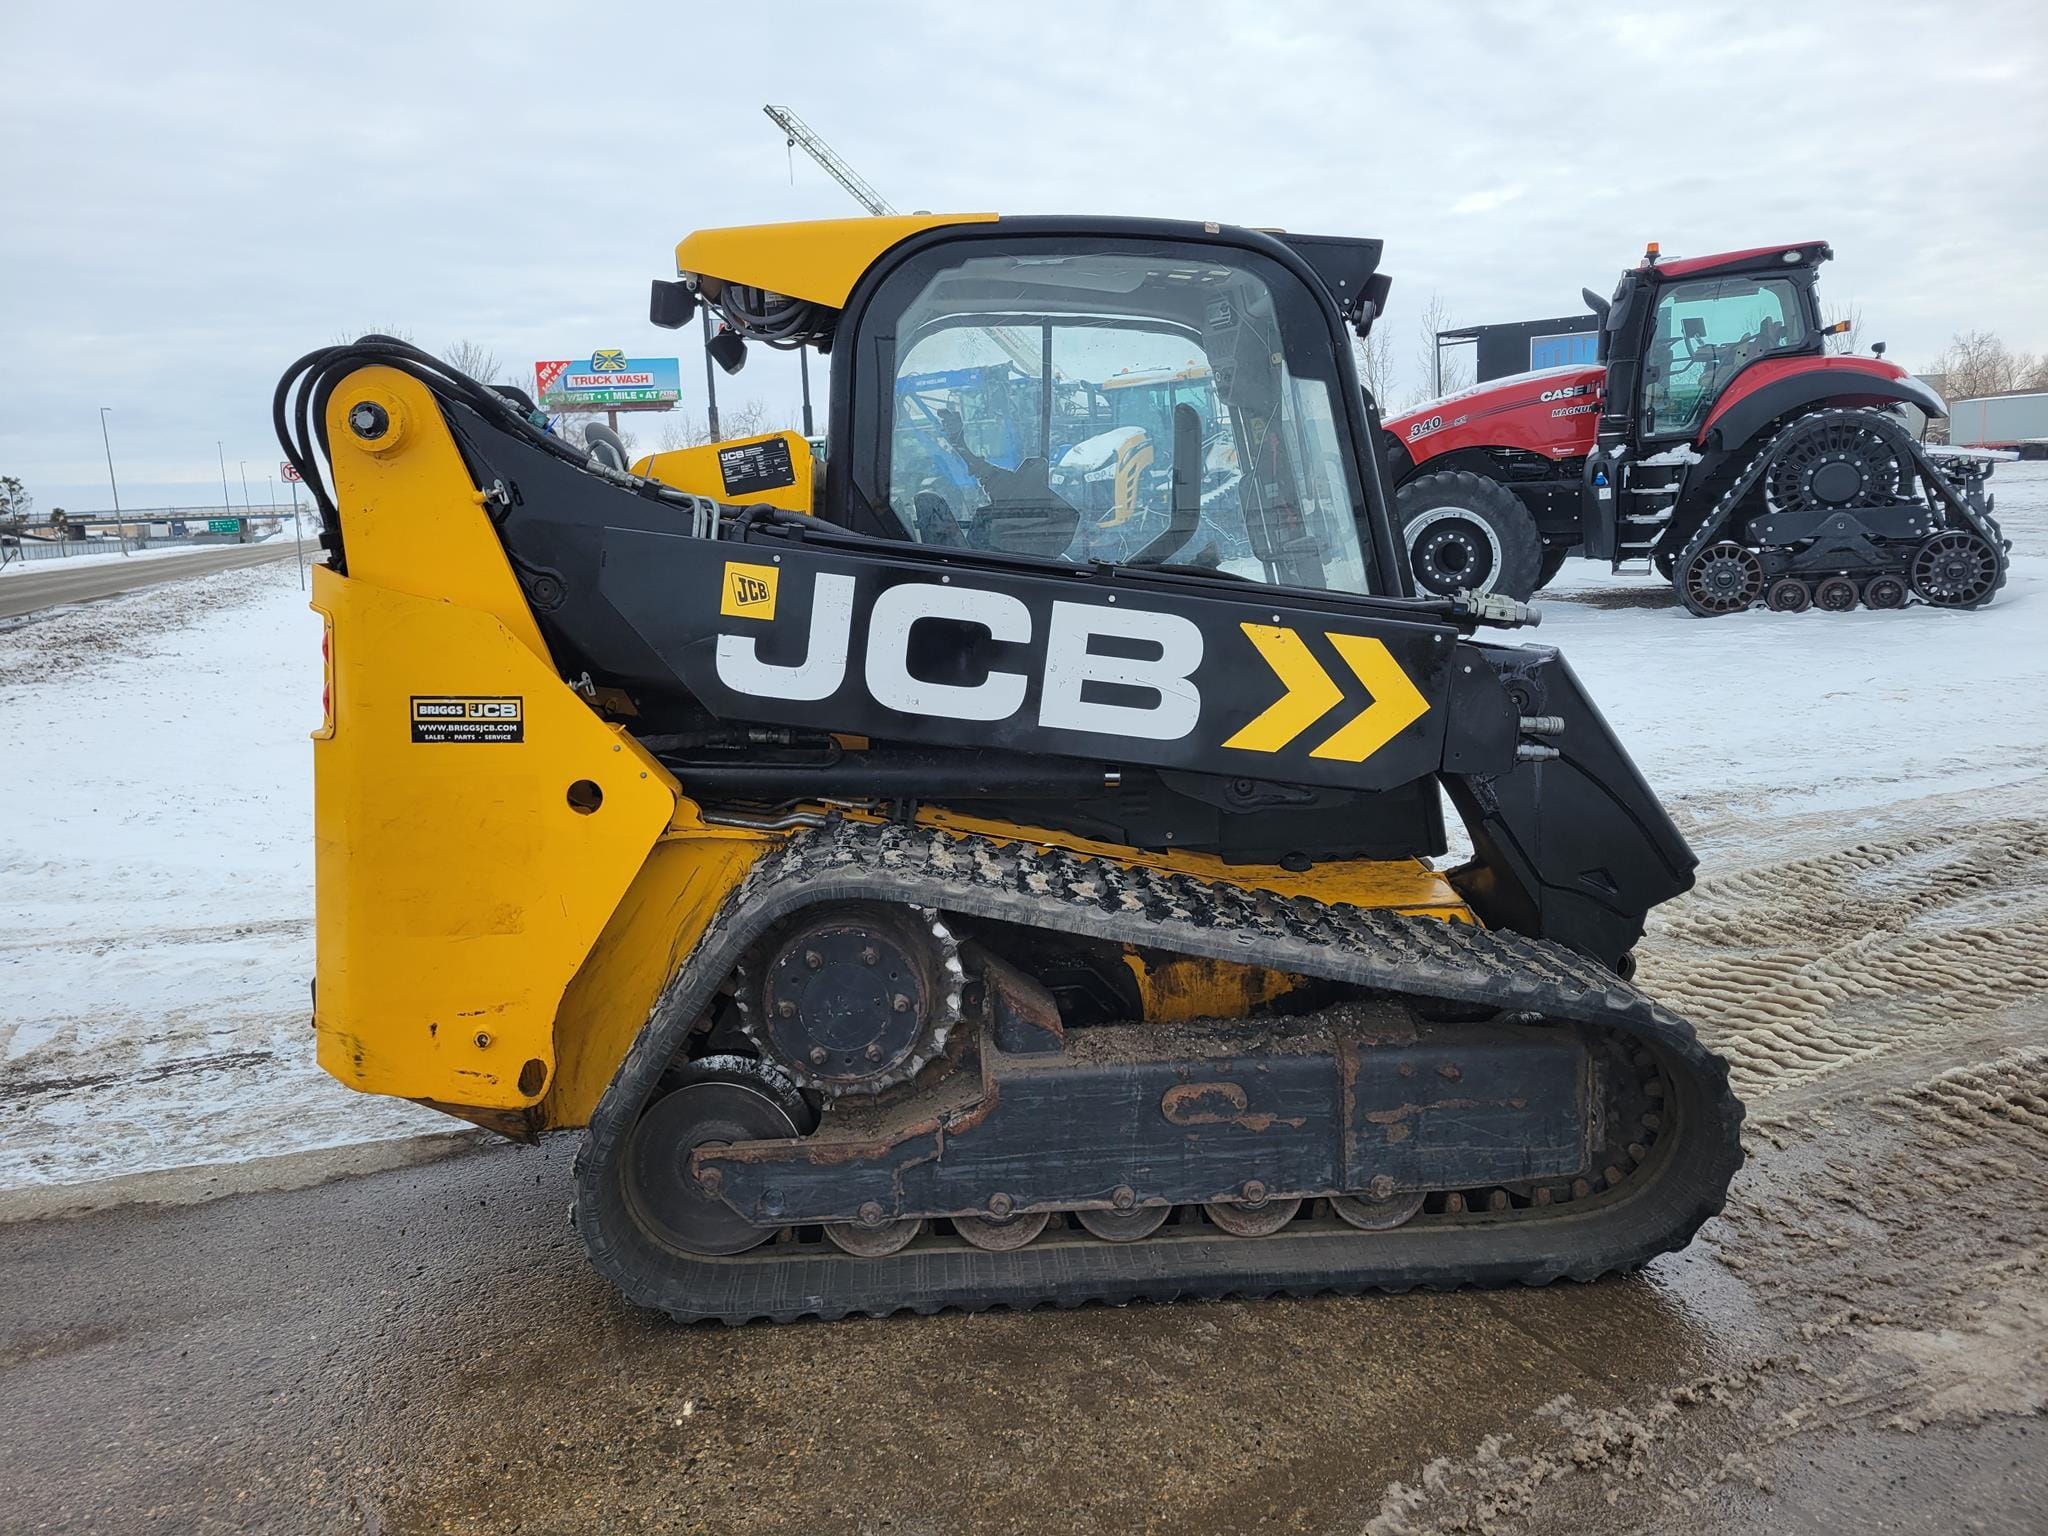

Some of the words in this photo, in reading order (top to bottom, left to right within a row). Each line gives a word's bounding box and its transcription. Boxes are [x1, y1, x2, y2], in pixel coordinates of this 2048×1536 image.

[573, 375, 612, 385] TRUCK
[615, 374, 649, 384] WASH
[604, 392, 609, 400] 1
[613, 391, 637, 400] MILE
[644, 391, 658, 399] AT
[1540, 384, 1584, 402] CASE
[1551, 403, 1593, 418] MAGNU
[1411, 416, 1442, 436] 340
[720, 450, 745, 461] JCB
[737, 576, 768, 603] JCB
[716, 572, 1204, 741] JCB
[419, 705, 464, 715] BRIGGS
[469, 703, 517, 717] JCB
[418, 724, 517, 733] WWW.BRIGGSJCB.COM
